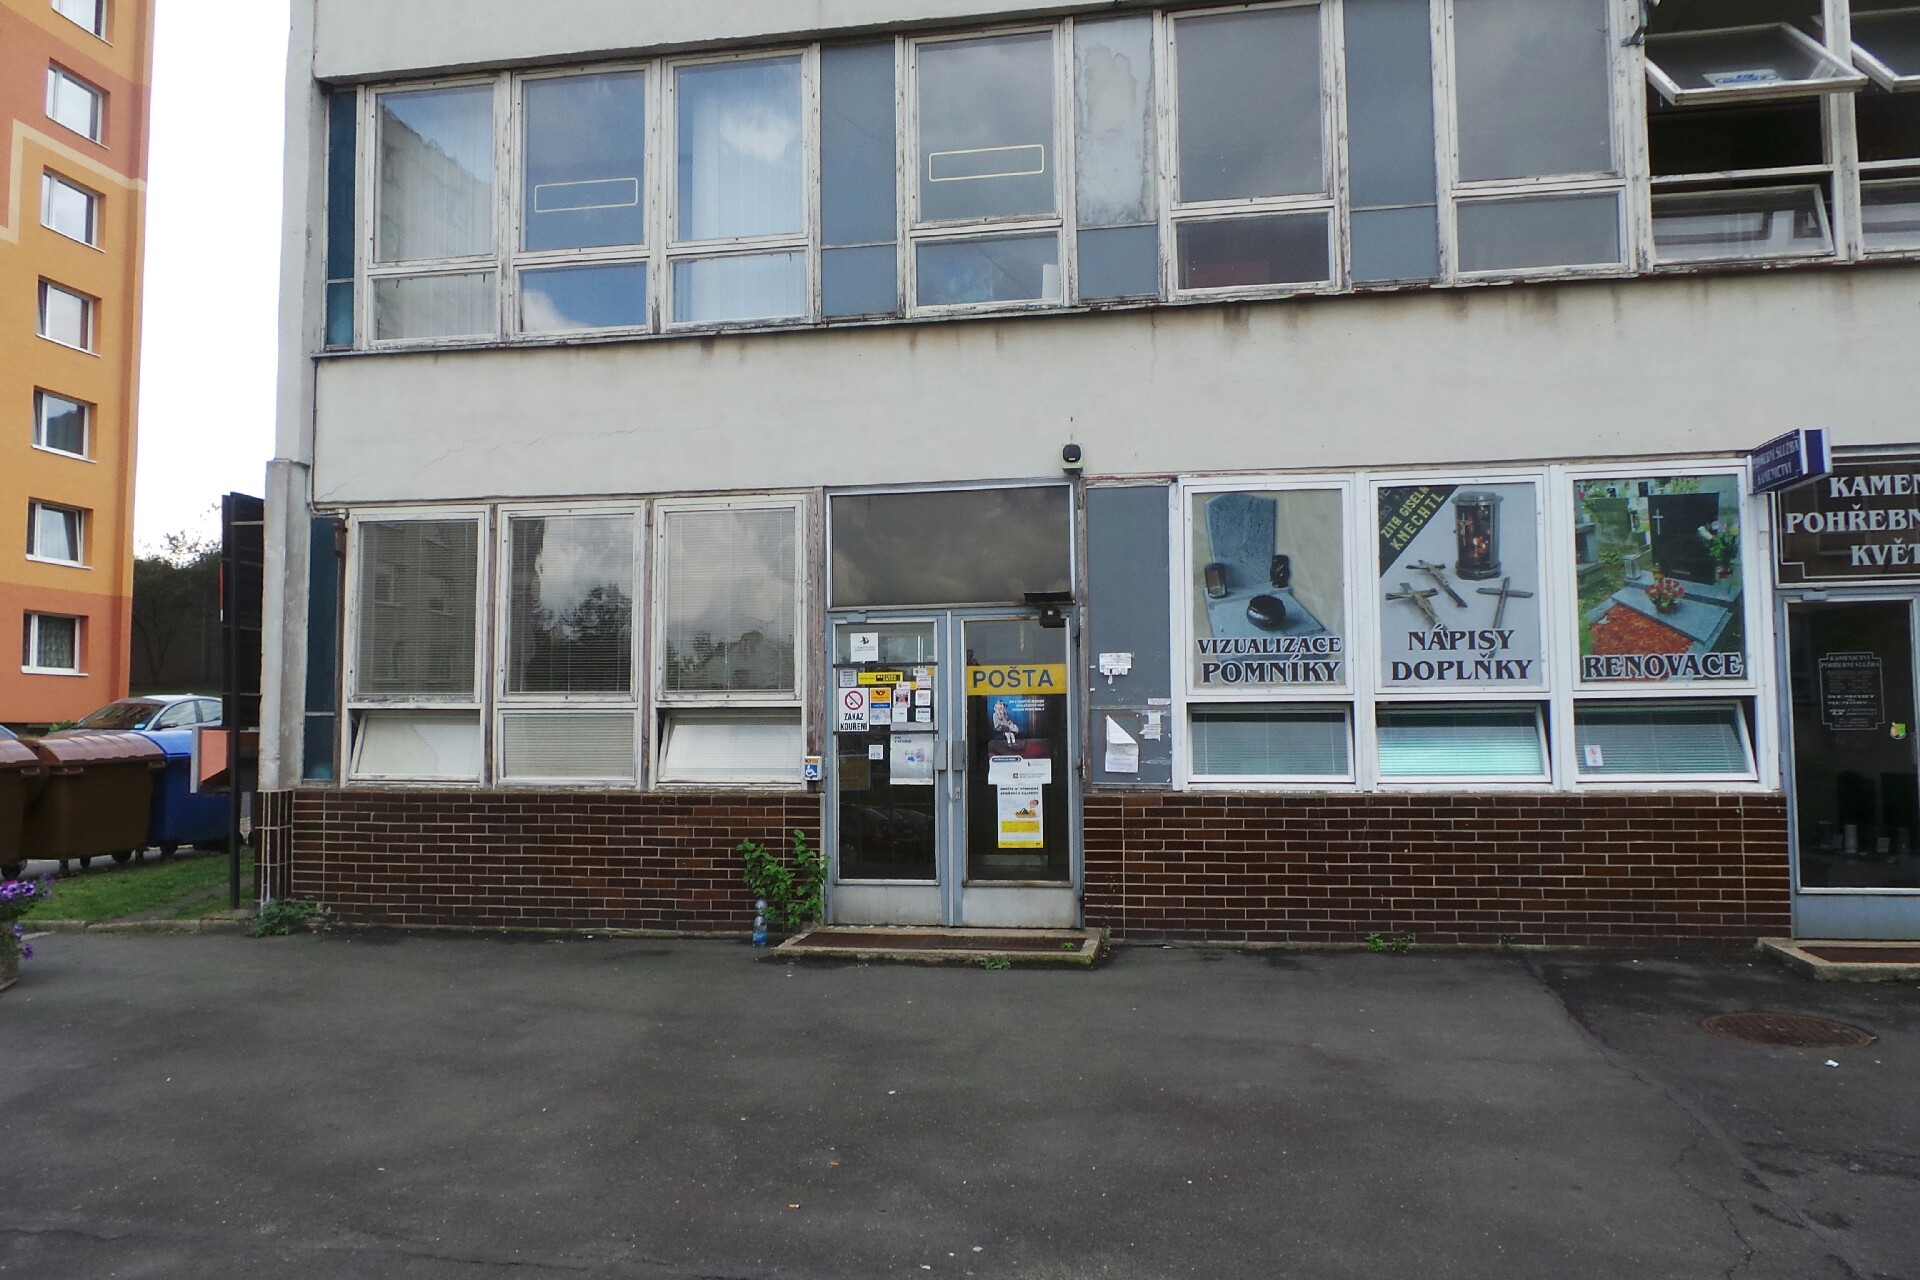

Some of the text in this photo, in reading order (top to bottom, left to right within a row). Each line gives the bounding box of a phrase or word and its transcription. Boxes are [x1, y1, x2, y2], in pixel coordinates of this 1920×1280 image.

[1390, 493, 1445, 550] KNECHTL
[1850, 537, 1920, 566] KVĚT
[1197, 637, 1342, 654] VIZUALIZACE
[1408, 624, 1514, 651] NÁPISY
[973, 666, 1053, 688] POŠTA
[1202, 654, 1341, 683] POMNÍKY
[1391, 652, 1533, 680] DOPLŇKY
[1582, 652, 1744, 679] RENOVACE
